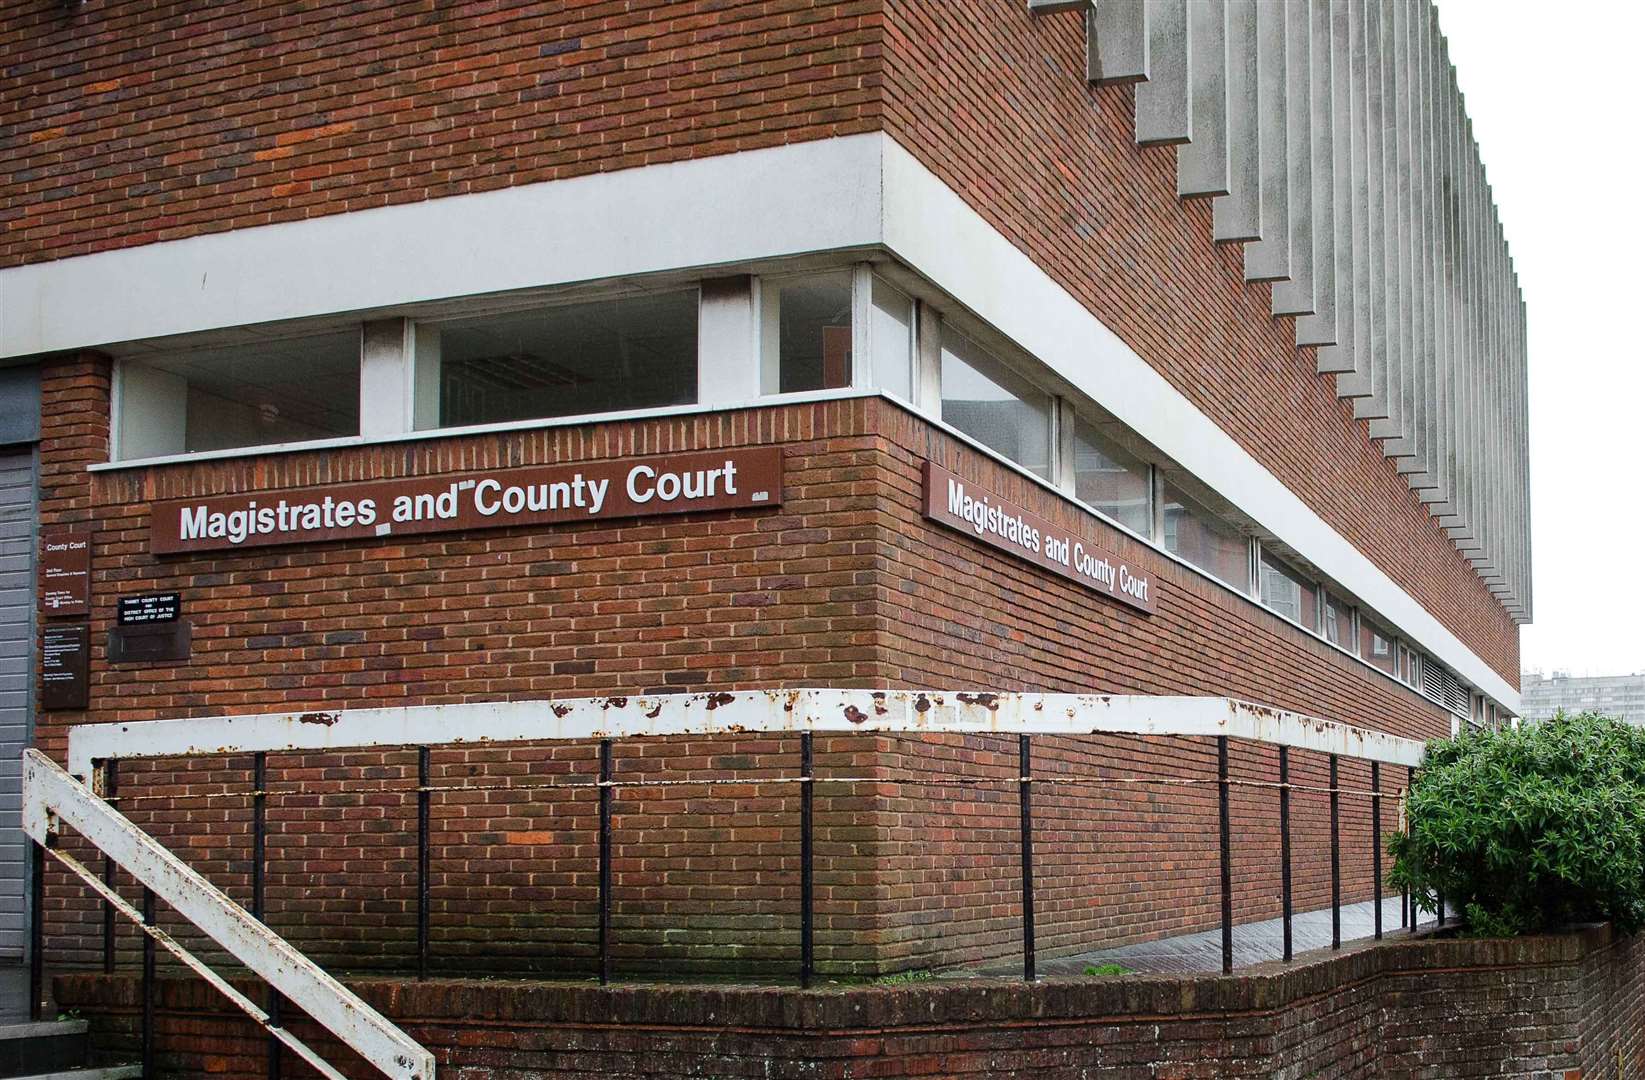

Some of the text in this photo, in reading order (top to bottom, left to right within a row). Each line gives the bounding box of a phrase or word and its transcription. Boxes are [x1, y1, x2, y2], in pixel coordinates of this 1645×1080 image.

[180, 460, 737, 544] Magistrates and County Court
[948, 478, 1149, 602] Magistrates and County Court
[47, 541, 86, 551] County Court
